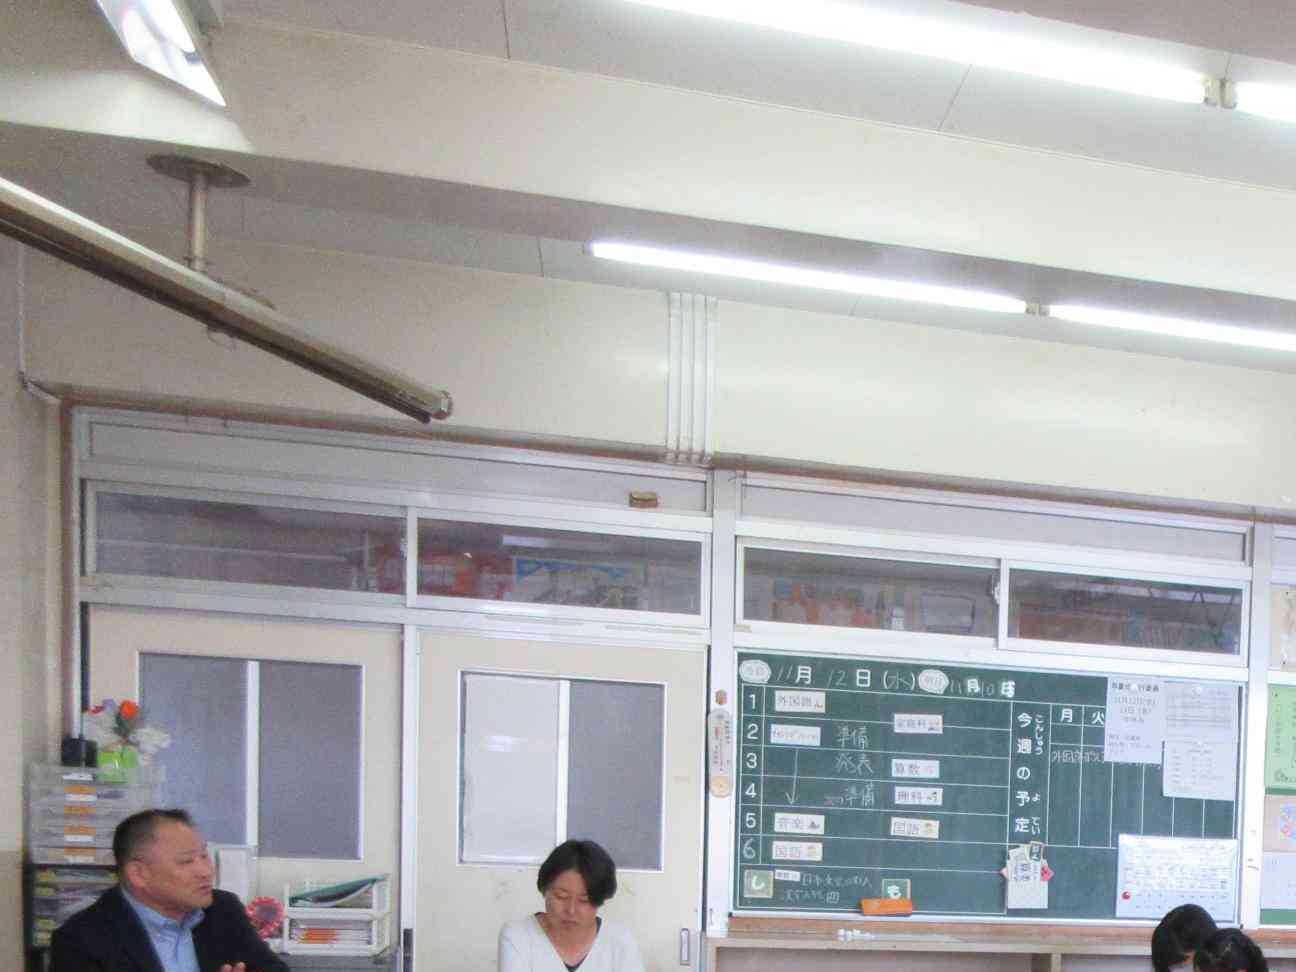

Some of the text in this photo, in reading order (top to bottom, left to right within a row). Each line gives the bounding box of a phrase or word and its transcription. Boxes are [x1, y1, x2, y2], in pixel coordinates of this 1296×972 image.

[748, 694, 757, 710] 1
[1060, 708, 1073, 723] 月
[746, 723, 759, 740] 2
[745, 752, 758, 769] 3
[745, 782, 757, 799] 4
[745, 812, 757, 829] 5
[742, 838, 756, 859] 6
